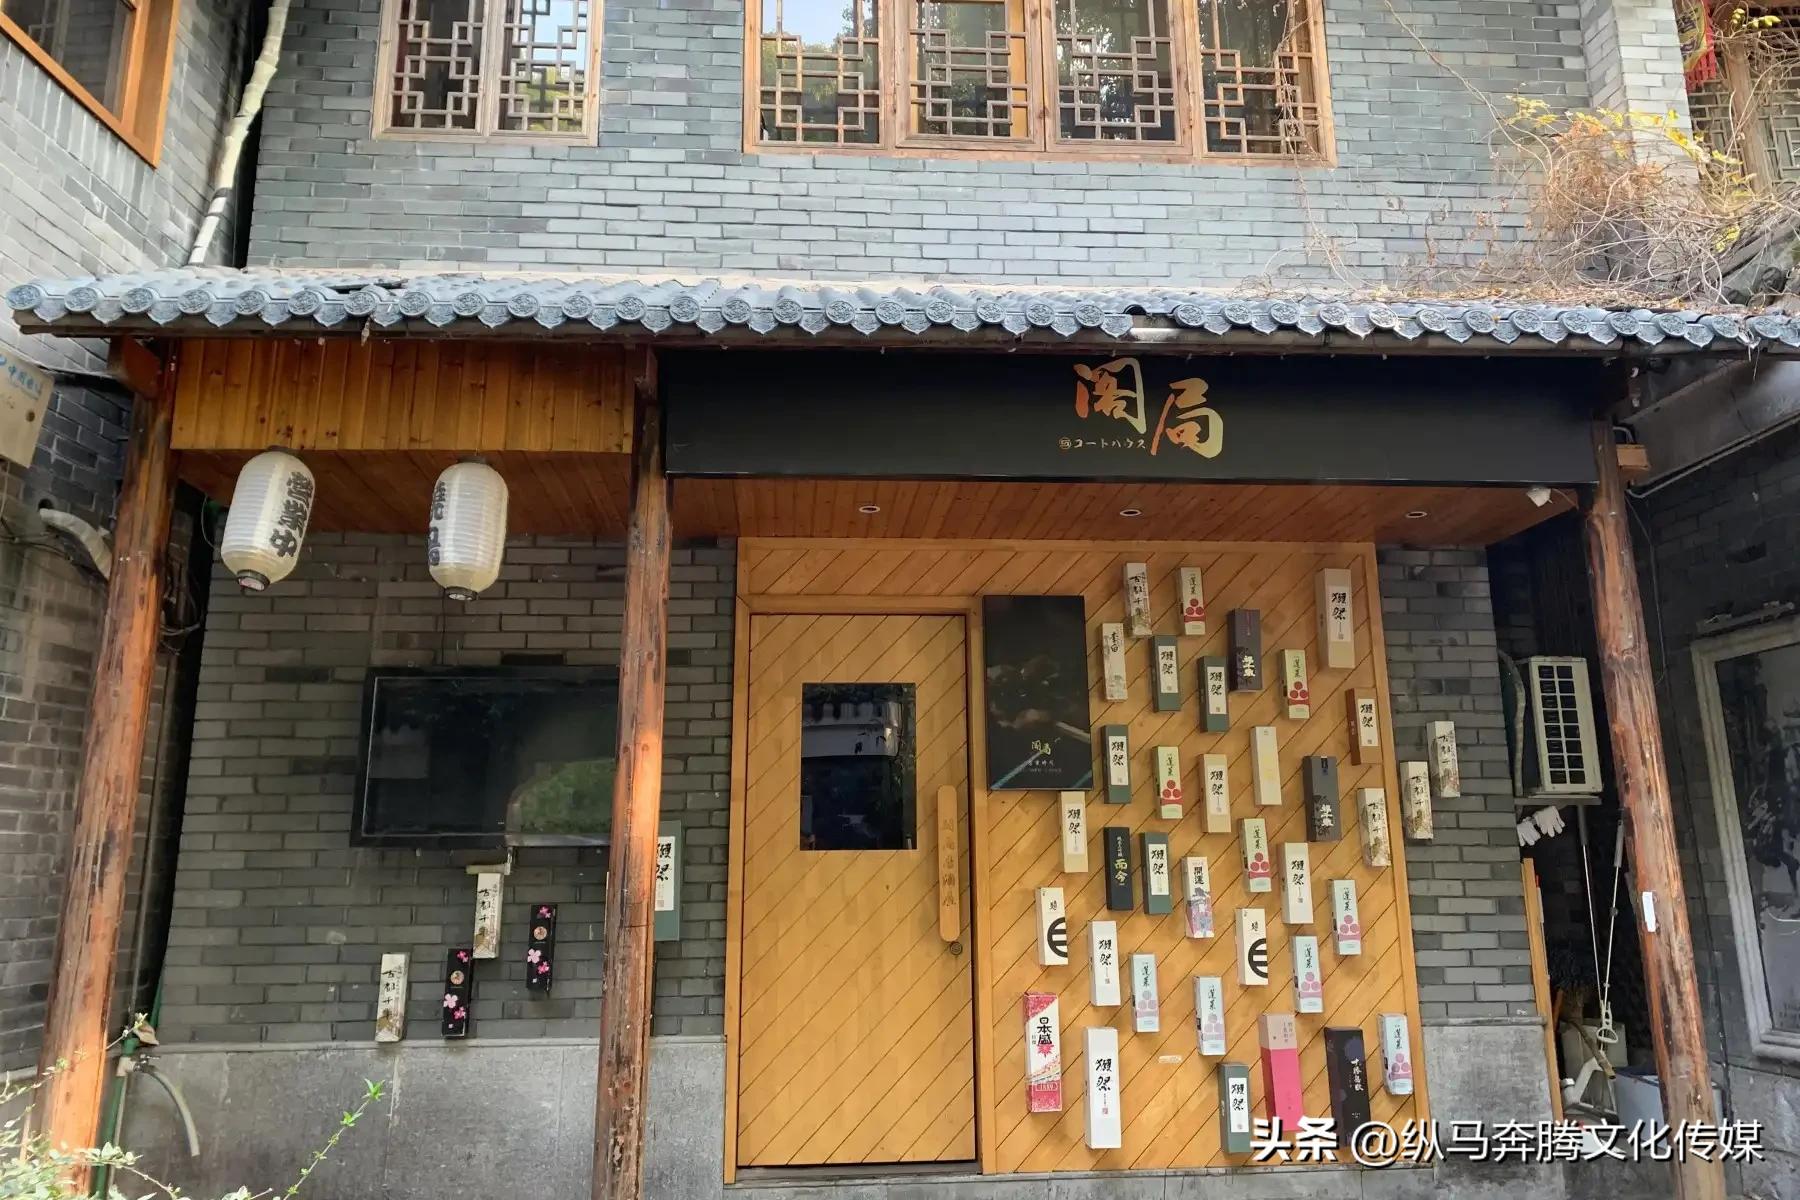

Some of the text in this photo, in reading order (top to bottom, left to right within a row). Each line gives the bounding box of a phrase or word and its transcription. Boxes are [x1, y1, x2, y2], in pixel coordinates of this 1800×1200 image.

[1115, 858, 1128, 883] 而今
[1037, 1017, 1052, 1046] 日本盛
